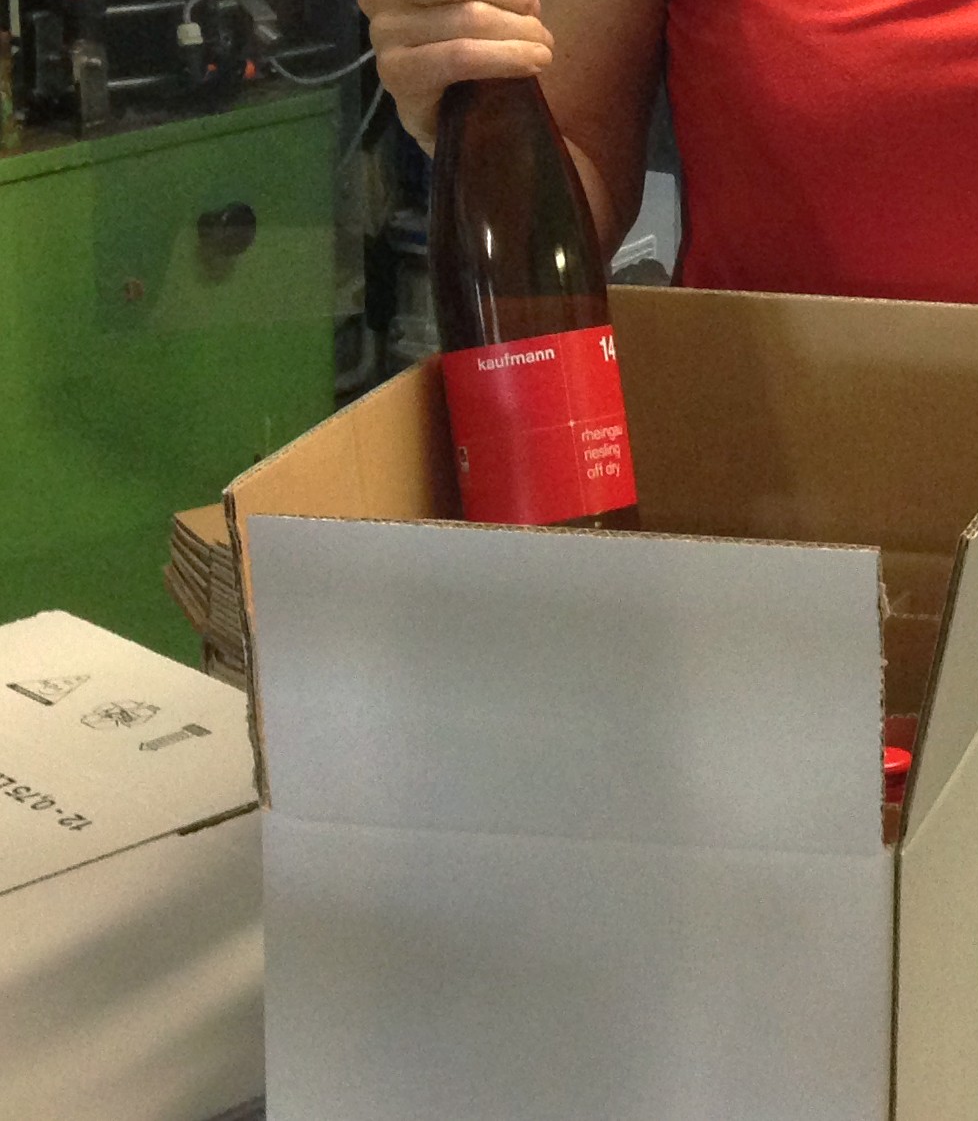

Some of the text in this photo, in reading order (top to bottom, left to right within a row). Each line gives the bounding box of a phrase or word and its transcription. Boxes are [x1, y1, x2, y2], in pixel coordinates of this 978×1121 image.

[477, 334, 617, 371] kaufmann 14
[584, 443, 621, 461] riesling
[587, 461, 620, 479] off dry
